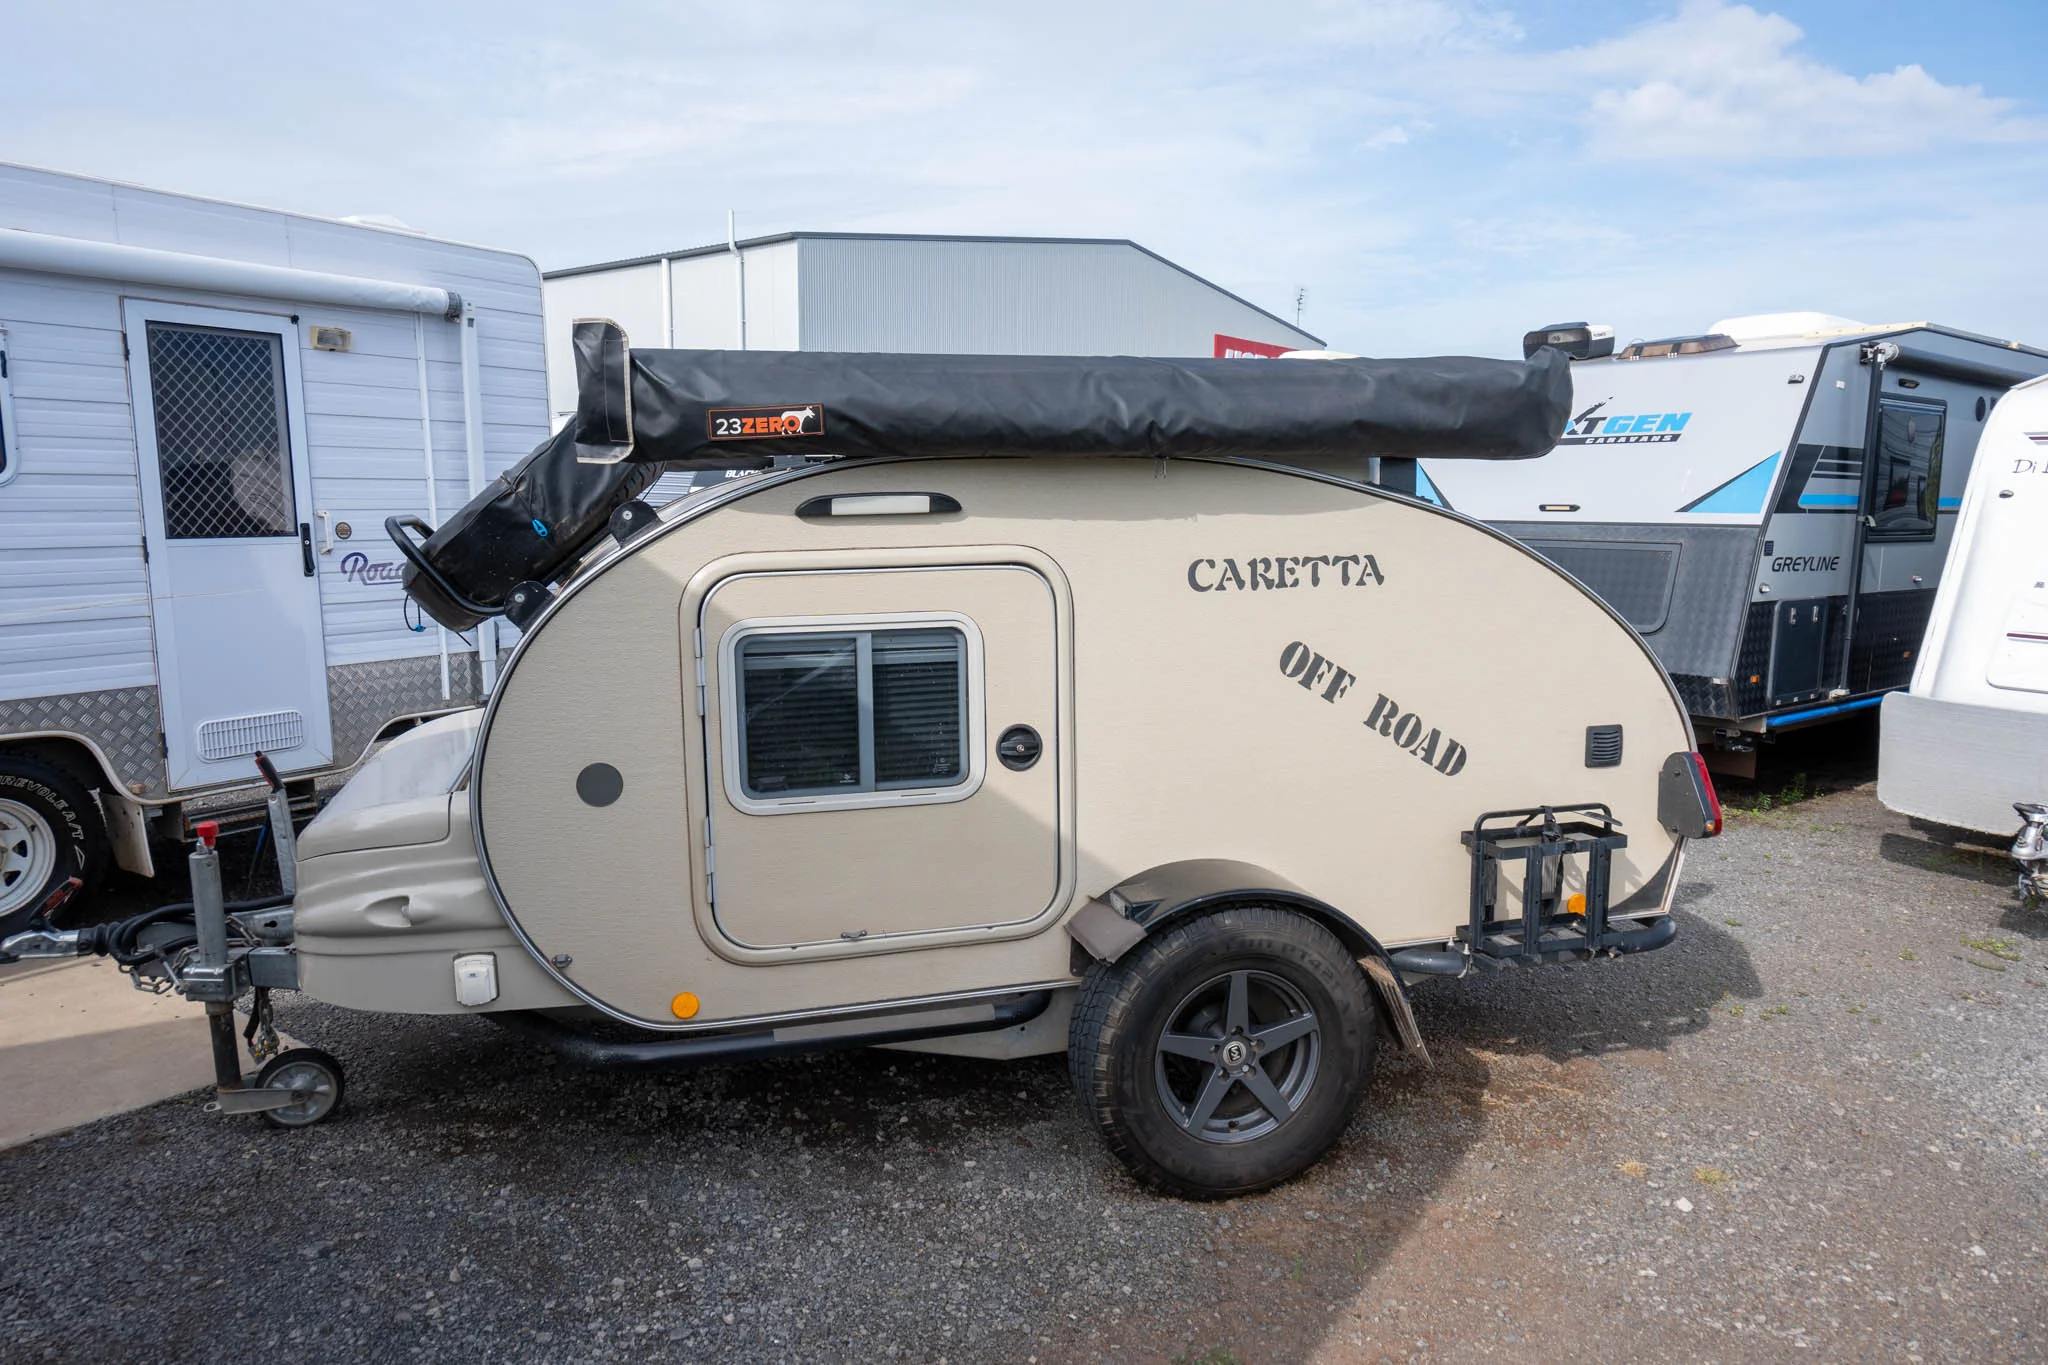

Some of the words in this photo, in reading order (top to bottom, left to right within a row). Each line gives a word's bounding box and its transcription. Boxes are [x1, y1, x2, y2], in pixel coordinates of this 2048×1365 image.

[715, 415, 801, 435] 23ZERO
[1585, 434, 1673, 445] CARAVANS
[2012, 459, 2037, 474] Di
[1187, 554, 1385, 593] CARETTA
[1771, 556, 1840, 573] GREYLINE
[1279, 640, 1357, 704] OFF
[1363, 693, 1468, 777] ROAD
[0, 775, 69, 811] REVOLE
